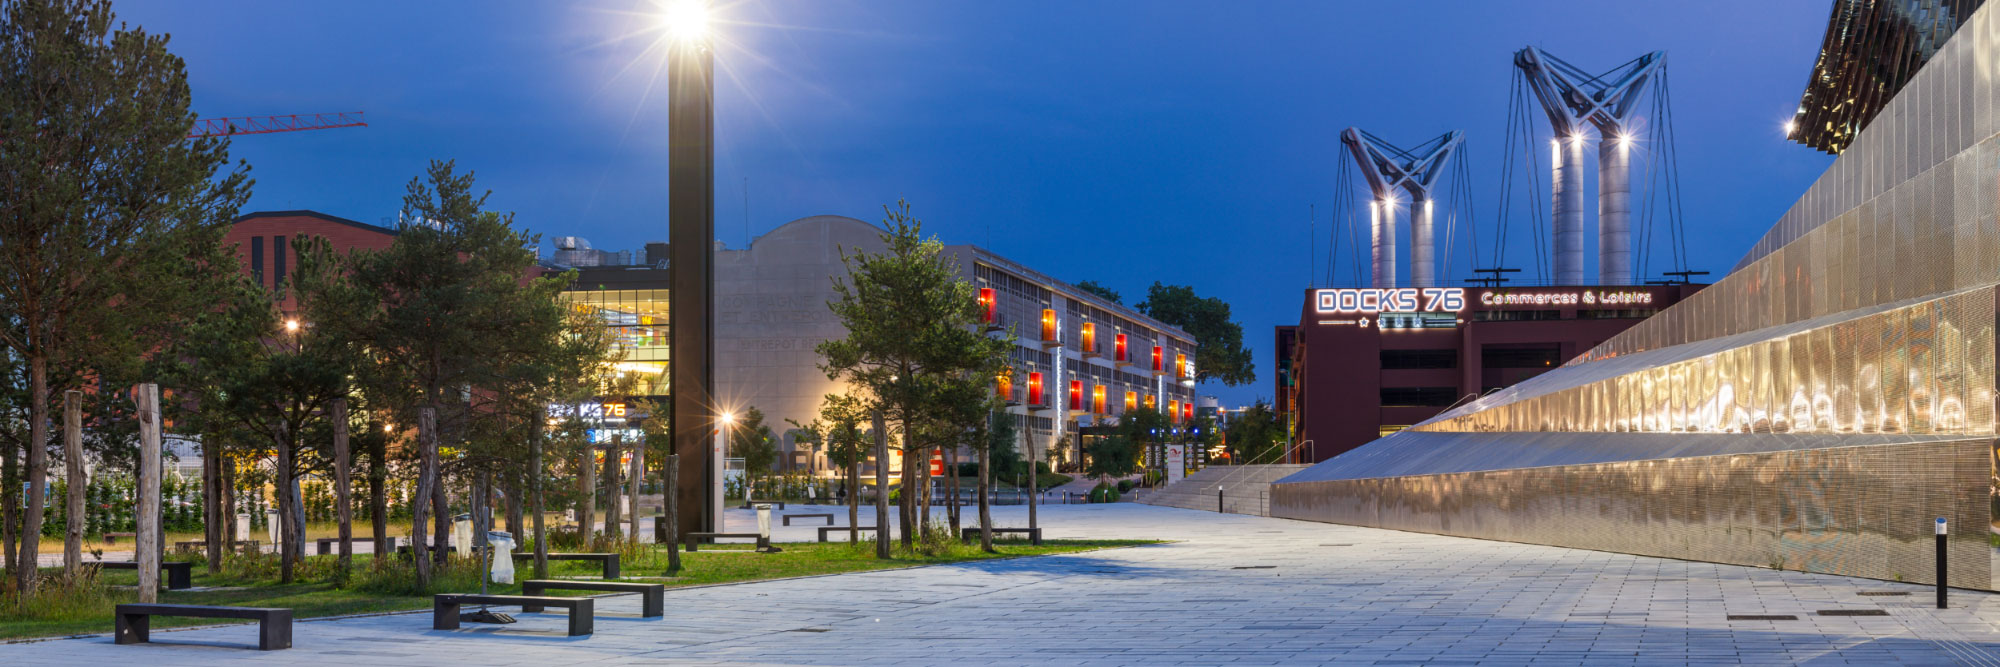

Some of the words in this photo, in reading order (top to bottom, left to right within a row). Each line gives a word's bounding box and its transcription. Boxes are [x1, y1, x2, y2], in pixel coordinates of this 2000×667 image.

[1317, 289, 1418, 312] DOCKS
[1423, 288, 1464, 311] 76
[1482, 291, 1578, 305] Commerces
[1583, 291, 1595, 304] &
[1600, 291, 1651, 304] Loisirs
[604, 403, 625, 416] 76
